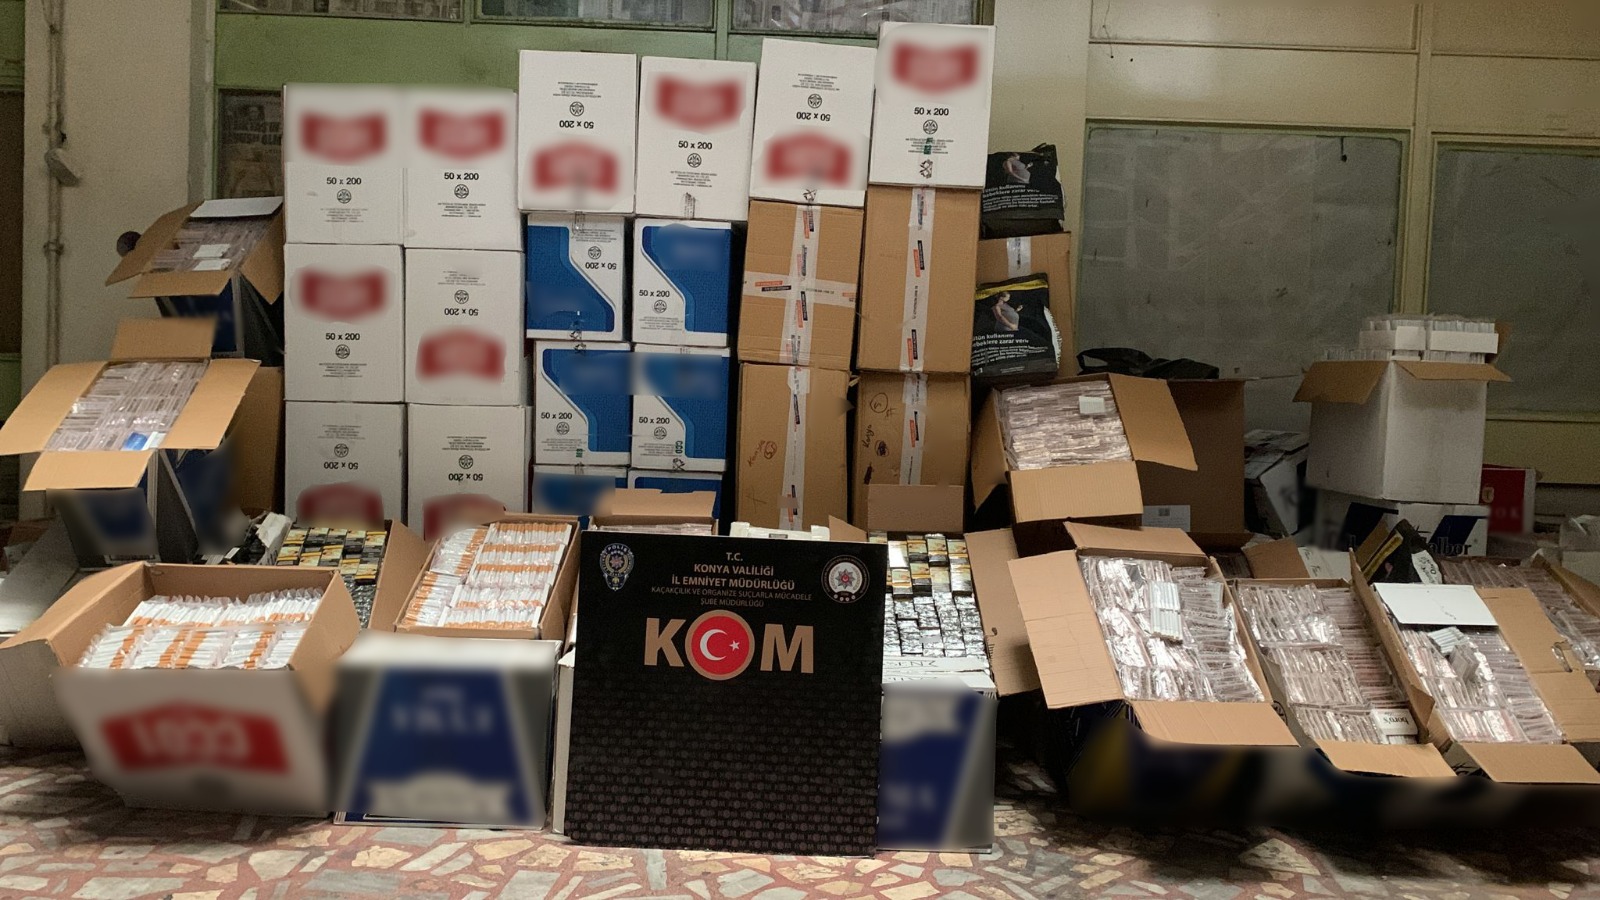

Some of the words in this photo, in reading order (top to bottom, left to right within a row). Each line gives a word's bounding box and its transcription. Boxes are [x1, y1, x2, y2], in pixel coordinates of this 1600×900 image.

[913, 106, 925, 116] 50
[933, 107, 950, 116] 200
[796, 111, 812, 121] 200
[820, 113, 831, 122] 50
[558, 119, 575, 129] 200
[583, 120, 595, 130] 50
[678, 140, 689, 149] 50
[697, 141, 713, 150] 200
[326, 176, 338, 185] 50
[346, 177, 362, 186] 200
[443, 172, 455, 181] 50
[463, 172, 480, 181] 200
[638, 289, 649, 298] 50
[443, 307, 460, 317] 200
[468, 308, 479, 317] 50
[325, 332, 336, 341] 50
[344, 332, 361, 341] 200
[558, 412, 573, 420] 200
[655, 417, 671, 425] 200
[323, 461, 339, 470] 200
[448, 472, 464, 481] 200
[472, 473, 484, 482] 50
[726, 552, 743, 561] T.C.
[694, 564, 730, 574] KONYA
[732, 565, 774, 576] VALİLİĞİ
[672, 574, 680, 585] İL
[683, 576, 726, 587] EMNİYET
[728, 578, 795, 590] MÜDÜRLÜĞÜ
[652, 586, 691, 595] KAÇAKÇILIK
[775, 592, 812, 600] MÜCADELE
[700, 598, 718, 606] ŞUBE
[719, 599, 764, 608] MÜDÜRLÜĞÜ
